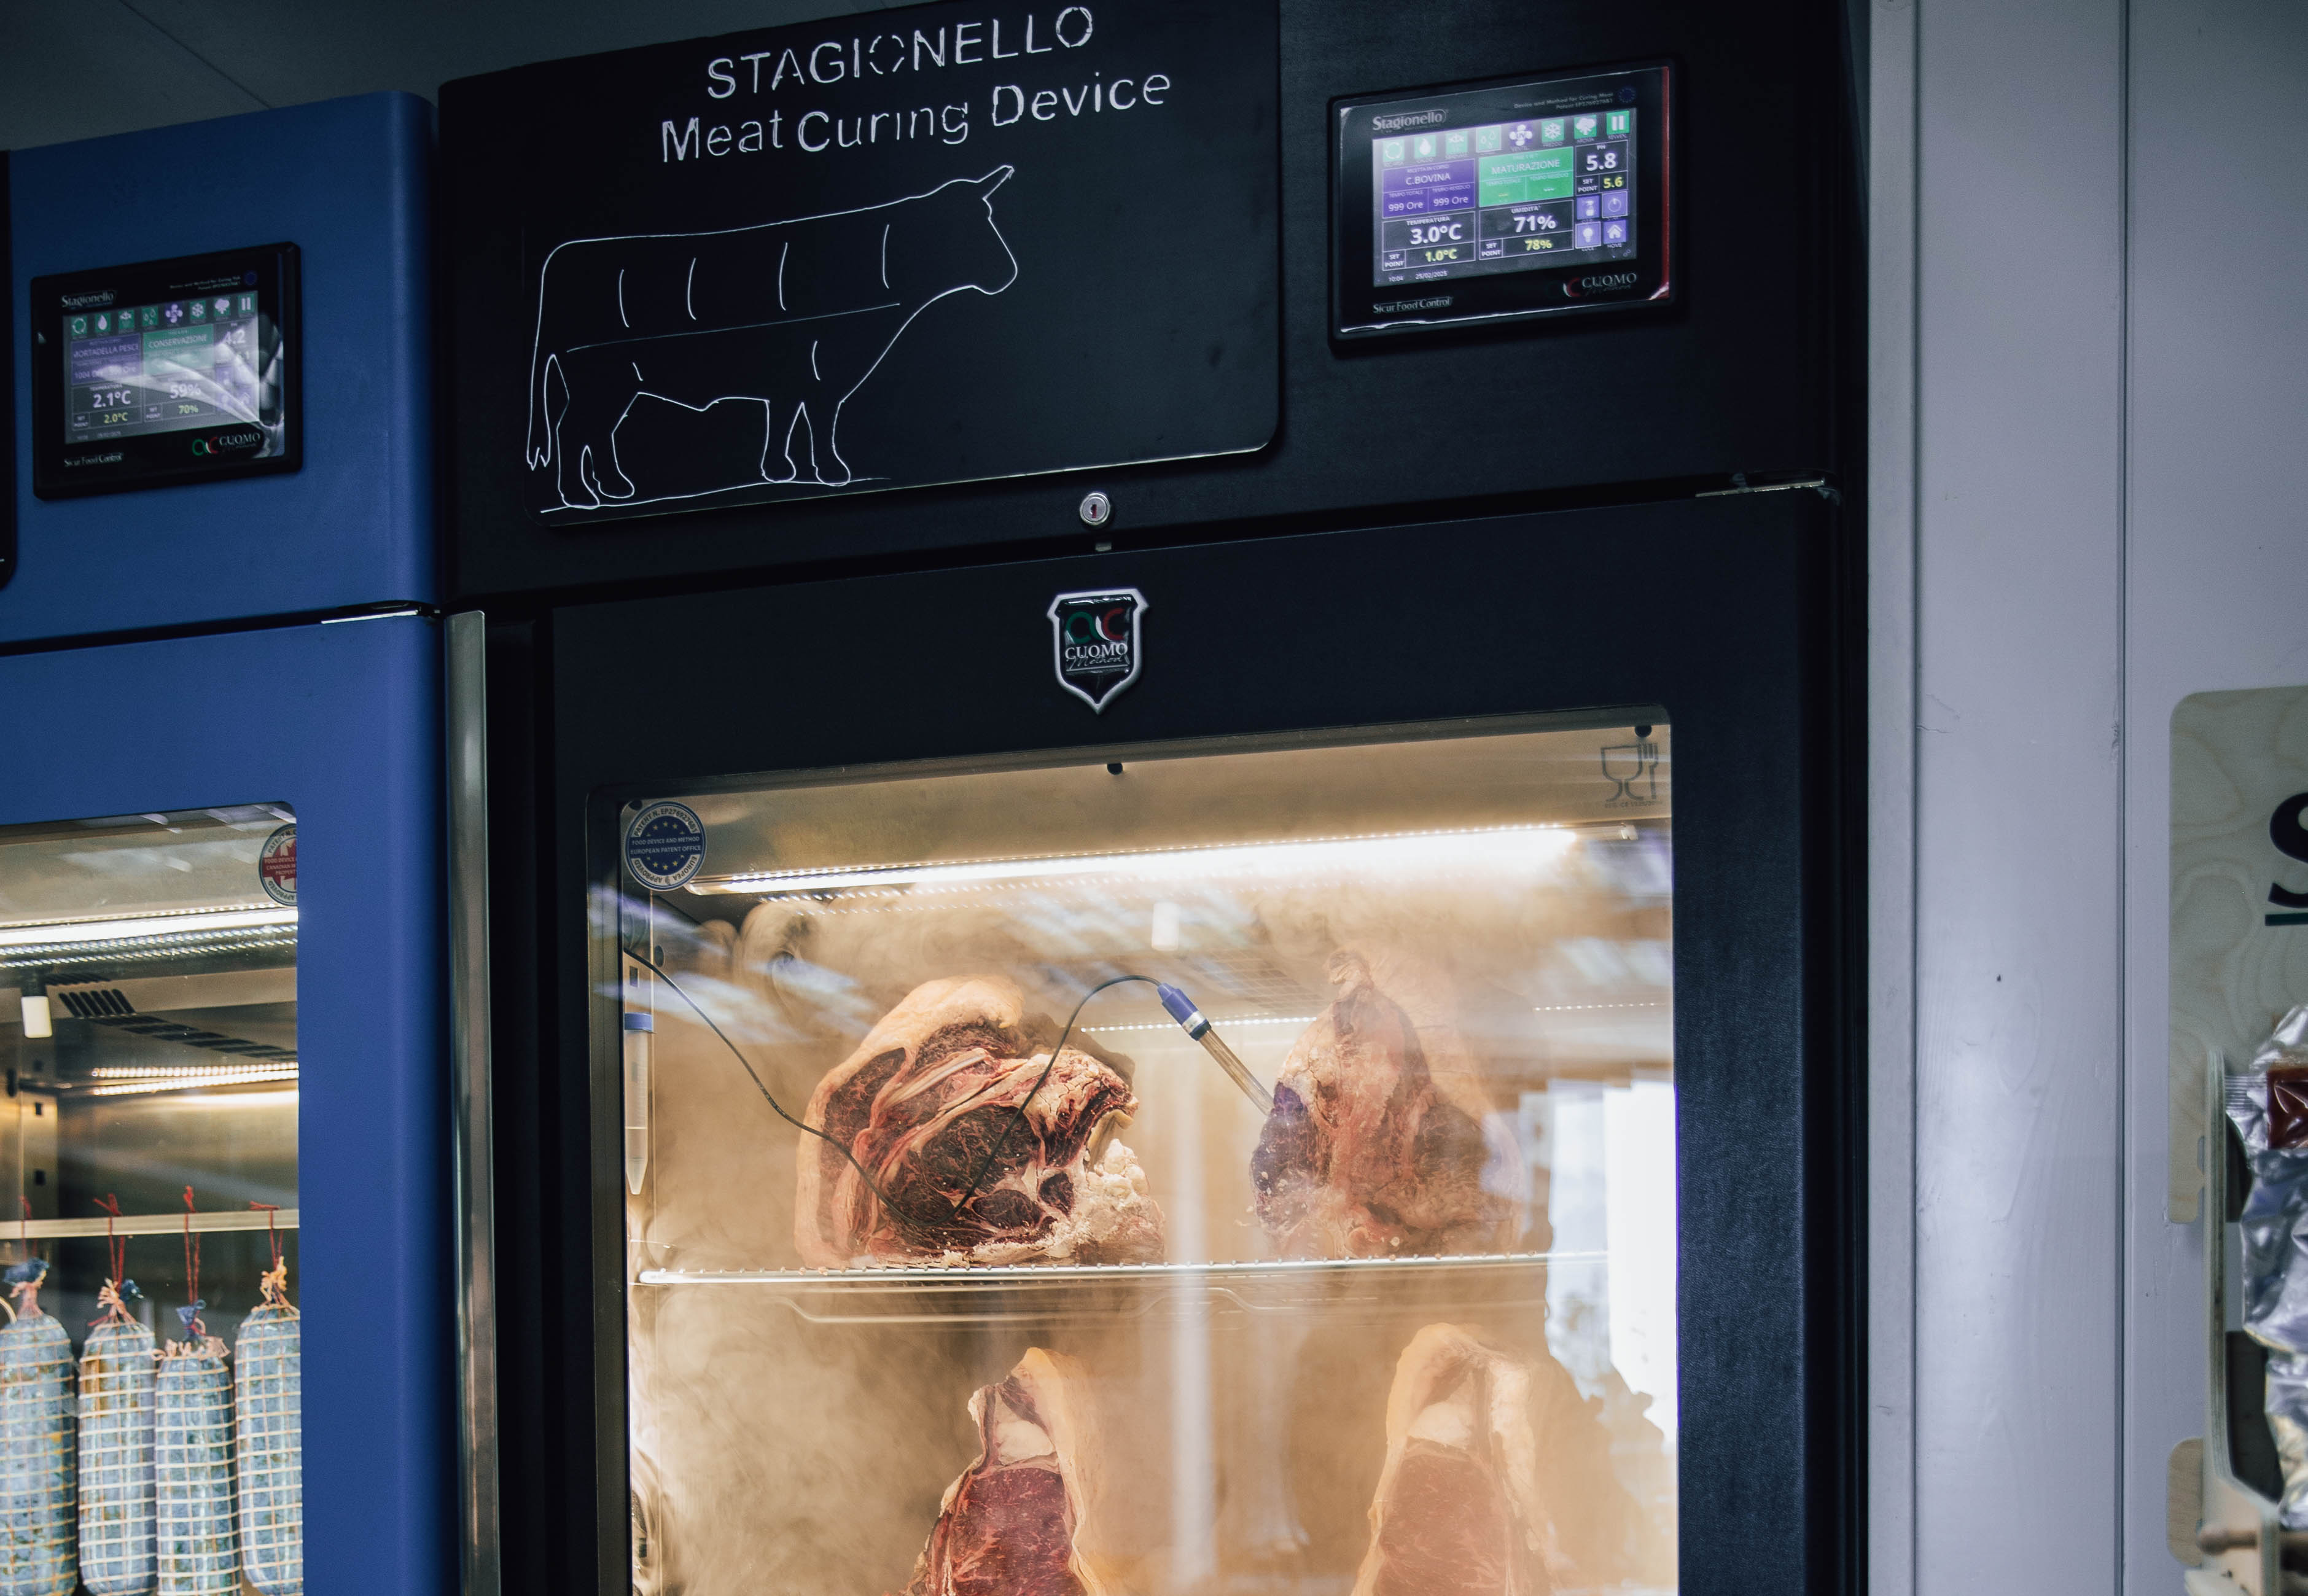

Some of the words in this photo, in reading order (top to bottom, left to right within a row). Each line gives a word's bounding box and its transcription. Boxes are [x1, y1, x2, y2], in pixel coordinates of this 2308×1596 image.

[708, 6, 1093, 99] STAGIONELLO
[662, 109, 784, 163] Meat
[798, 102, 969, 152] Curing
[992, 71, 1171, 127] Device
[1373, 112, 1443, 131] Stagionello
[1492, 159, 1561, 175] MATURAZIONE
[1586, 152, 1616, 171] 5.8
[1405, 173, 1451, 185] C.BOVINA
[1603, 176, 1623, 189] 5.6
[1388, 203, 1405, 212] 999
[1433, 198, 1449, 206] 999
[1451, 196, 1469, 204] Ore
[1406, 216, 1451, 226] TEMPERATURA
[1513, 215, 1557, 233] 71%
[1410, 224, 1462, 245] 3.0°C
[1524, 239, 1553, 251] 78%
[1424, 248, 1457, 262] 1.0°C
[1581, 272, 1637, 288] CUOMO
[61, 290, 114, 308] Stagionello
[1373, 303, 1395, 314] Sicur
[1396, 301, 1418, 311] Food
[1419, 298, 1450, 308] Control
[147, 333, 208, 349] CONSERVAZIONE
[93, 389, 131, 408] 2.1°C
[169, 381, 203, 400] 59%
[178, 403, 199, 415] 70%
[104, 412, 128, 424] 2.0°C
[219, 432, 261, 446] CUOMO
[1064, 642, 1128, 660] CUOMO
[633, 859, 663, 884] APPROVED
